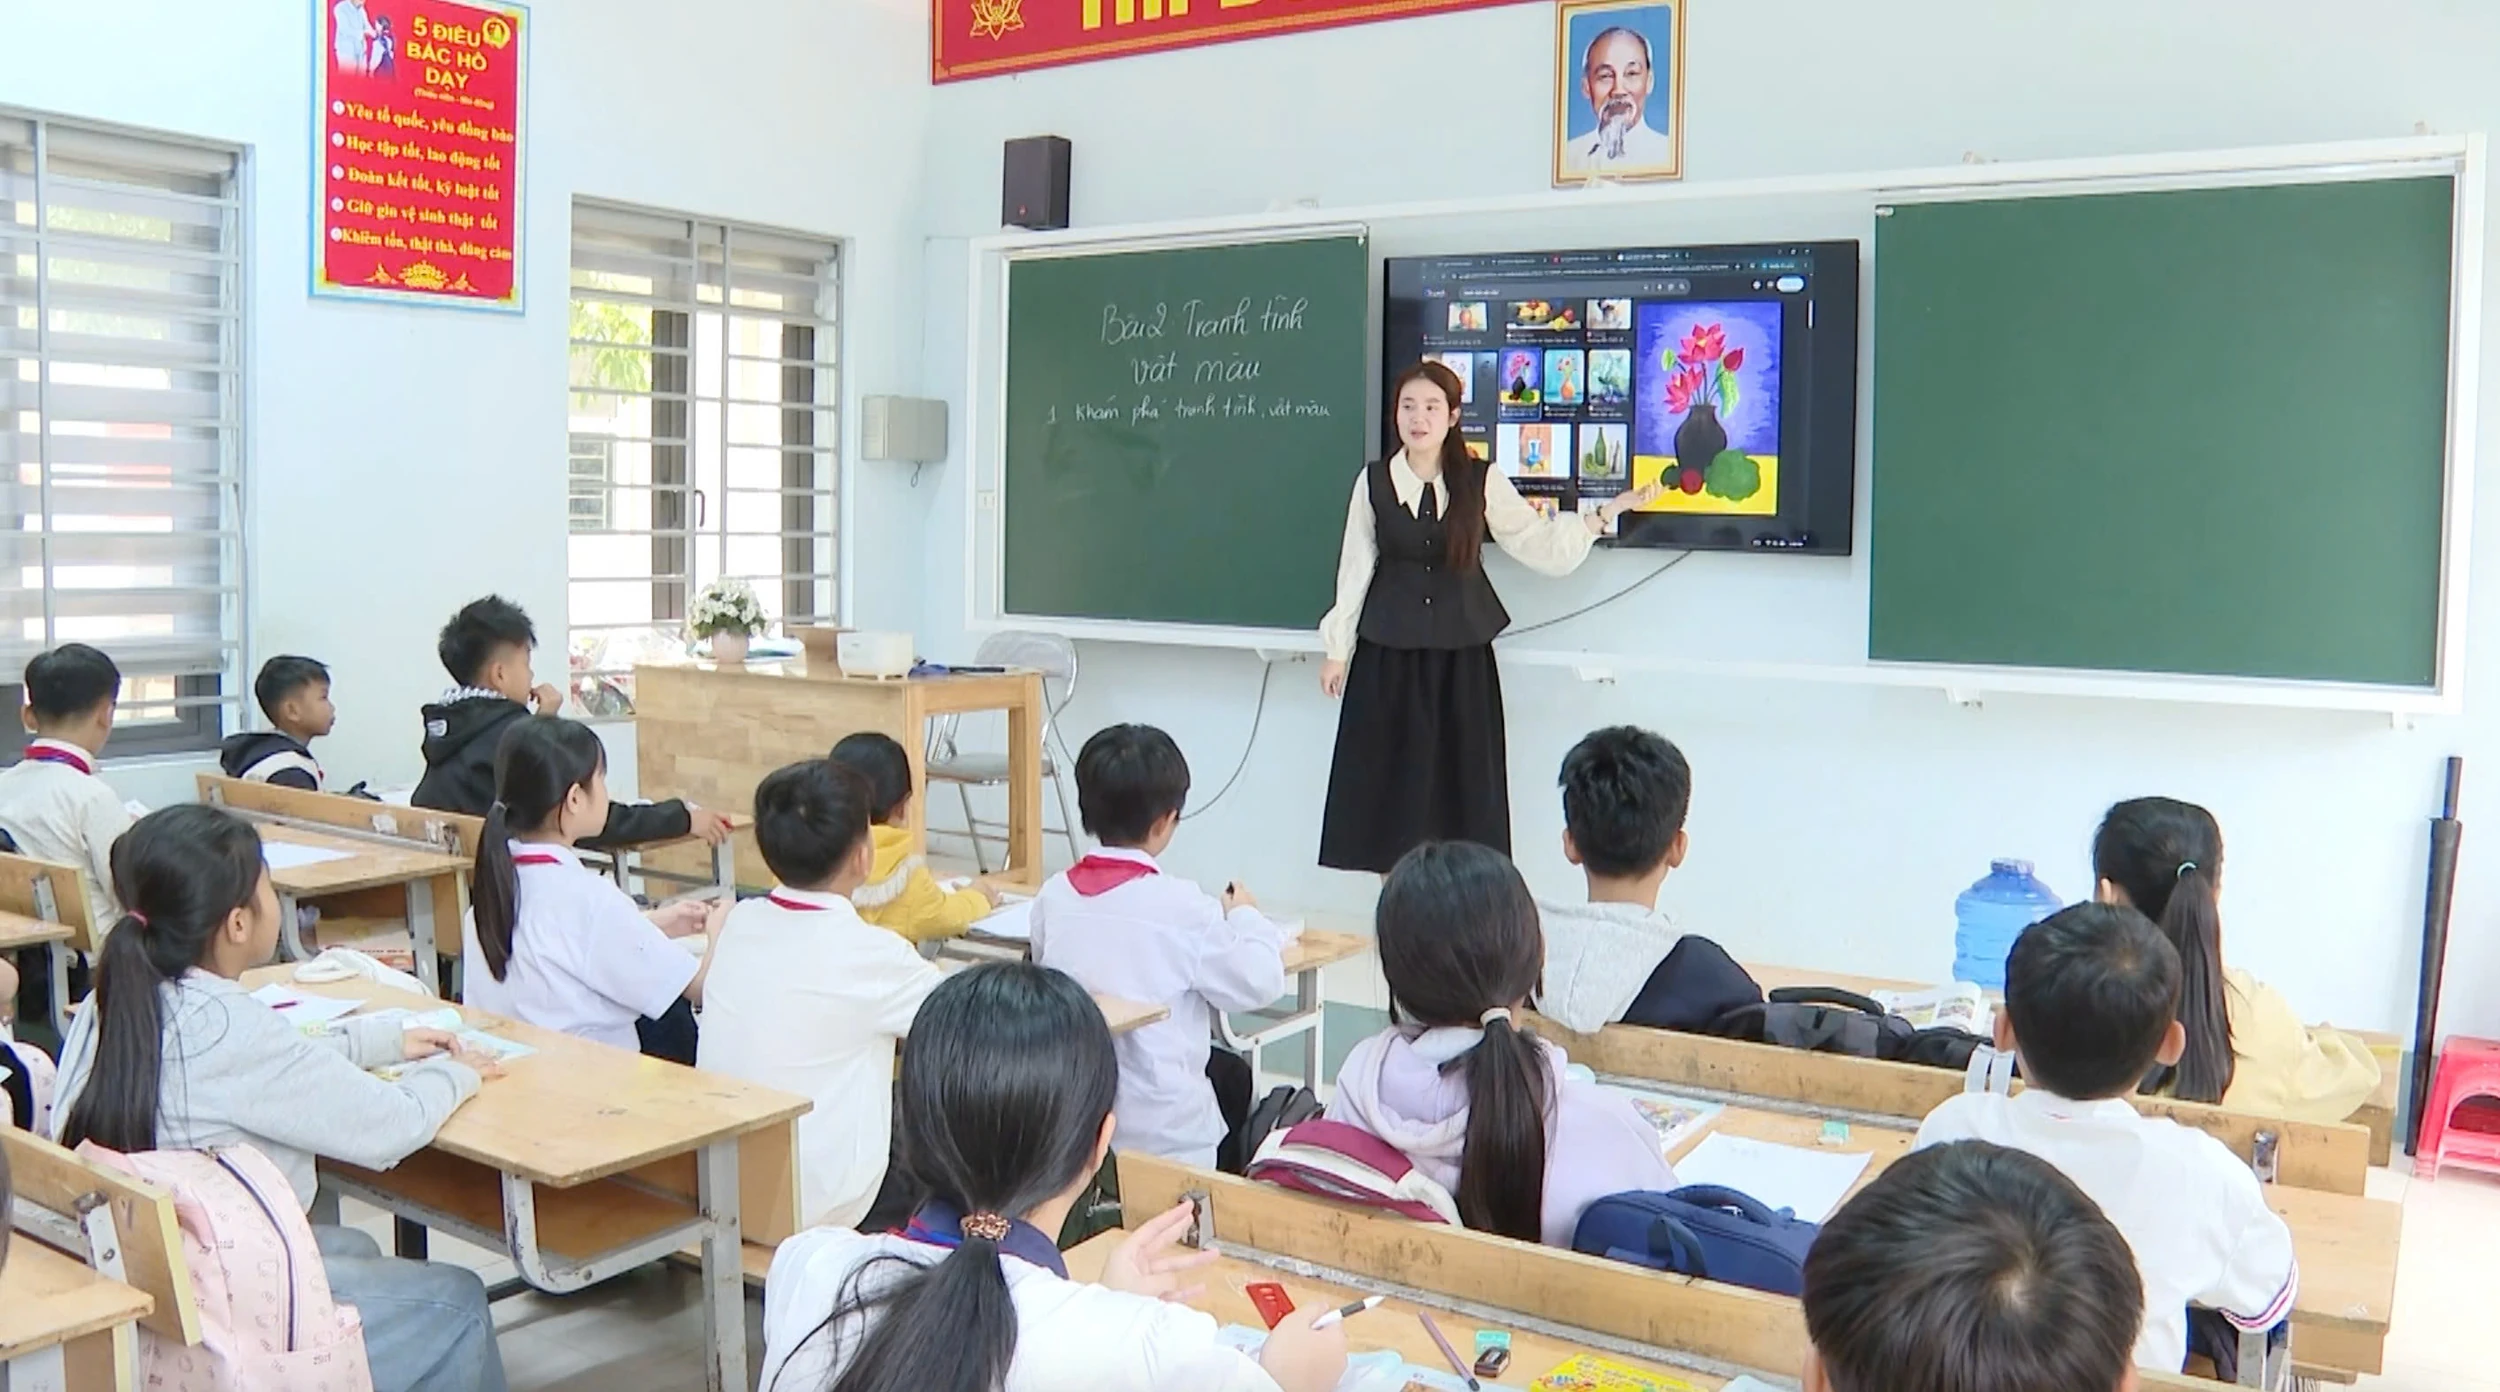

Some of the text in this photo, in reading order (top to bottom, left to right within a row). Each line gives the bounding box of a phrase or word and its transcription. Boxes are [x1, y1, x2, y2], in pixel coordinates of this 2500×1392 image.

[412, 15, 428, 37] 5
[425, 66, 469, 91] DẠY
[1183, 297, 1251, 338] Tranh
